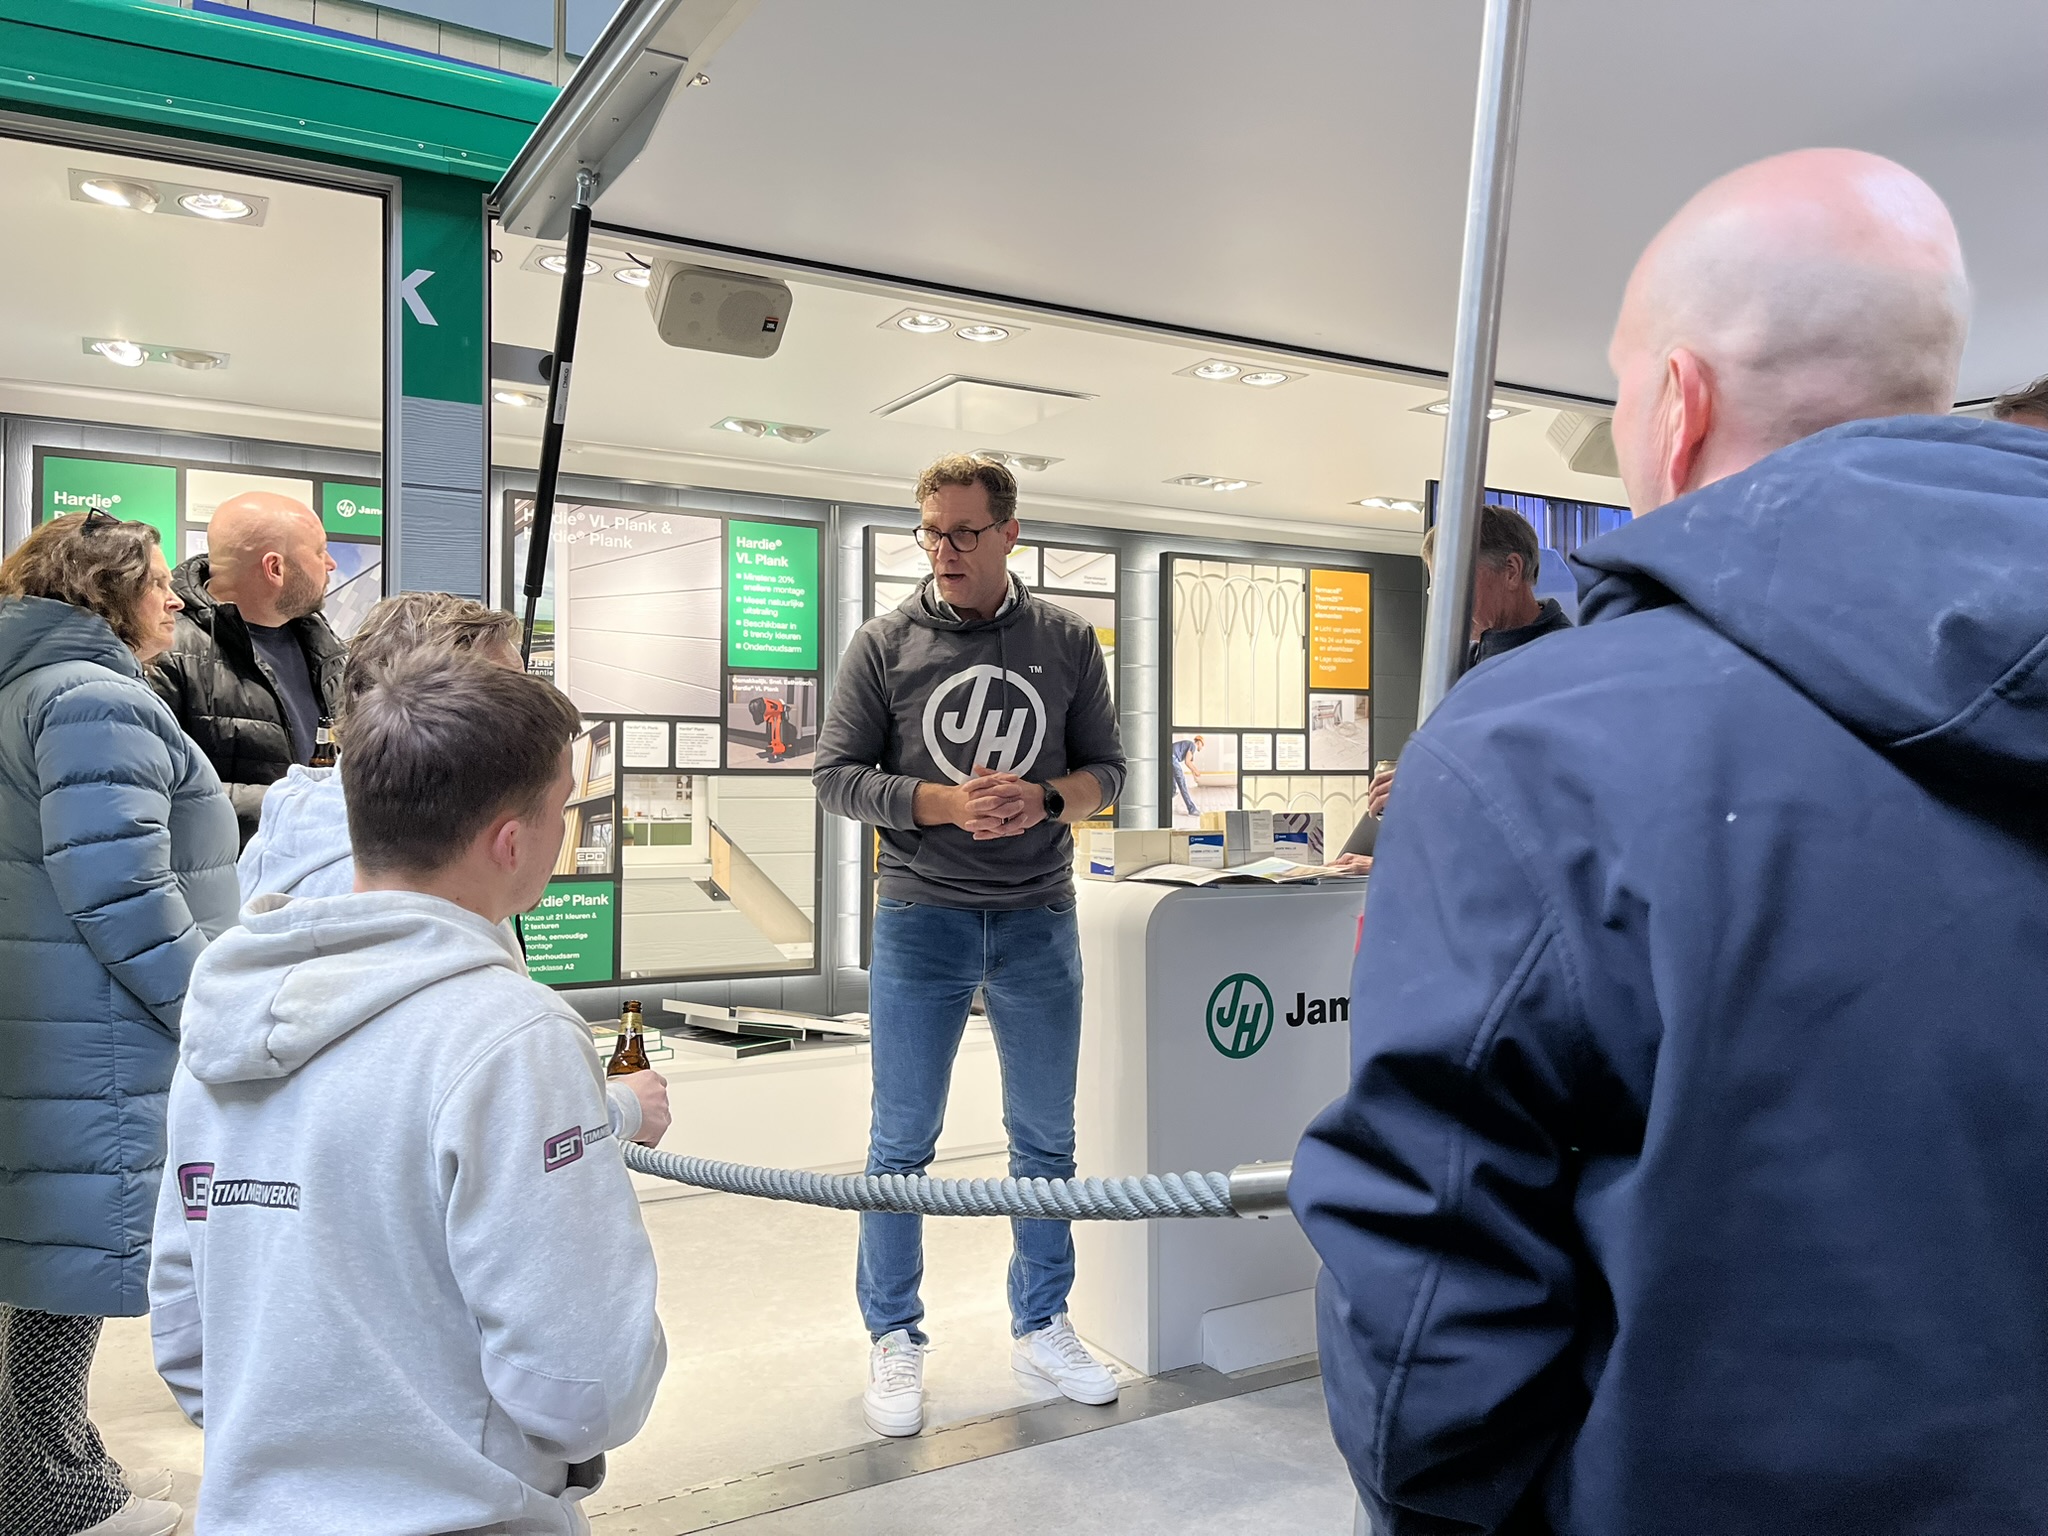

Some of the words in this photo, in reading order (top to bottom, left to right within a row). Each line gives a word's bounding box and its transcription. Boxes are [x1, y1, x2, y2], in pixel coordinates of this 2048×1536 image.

[54, 490, 122, 509] Hardie®
[523, 508, 586, 526] Hdie®
[589, 514, 609, 529] VL
[615, 516, 657, 533] Plank
[661, 521, 673, 535] &
[523, 527, 586, 544] Hdie®
[589, 533, 633, 549] Plank
[736, 536, 783, 551] Hardie®
[736, 552, 752, 565] VL
[755, 553, 789, 568] Plank
[743, 572, 777, 583] Minstens
[778, 575, 795, 584] 20%
[773, 586, 806, 597] montage
[743, 596, 766, 605] Meest
[768, 598, 804, 608] natuurlijke
[743, 607, 779, 618] uitstraling
[743, 619, 788, 630] Beschikbaar
[790, 622, 797, 630] in
[743, 629, 749, 638] 8
[750, 630, 773, 640] trendy
[775, 631, 802, 641] kleuren
[743, 642, 803, 653] Onderhoudsarm
[534, 658, 553, 668] jaar
[1028, 665, 1043, 674] TM
[537, 893, 571, 907] rdie®
[572, 893, 609, 907] Plank
[524, 914, 545, 922] Keuze
[546, 913, 554, 921] uit
[555, 913, 563, 921] 21
[565, 912, 590, 920] kleuren
[531, 922, 559, 931] texturen
[549, 932, 588, 941] eenvoudige
[565, 962, 575, 971] A2
[1213, 974, 1267, 1057] JH
